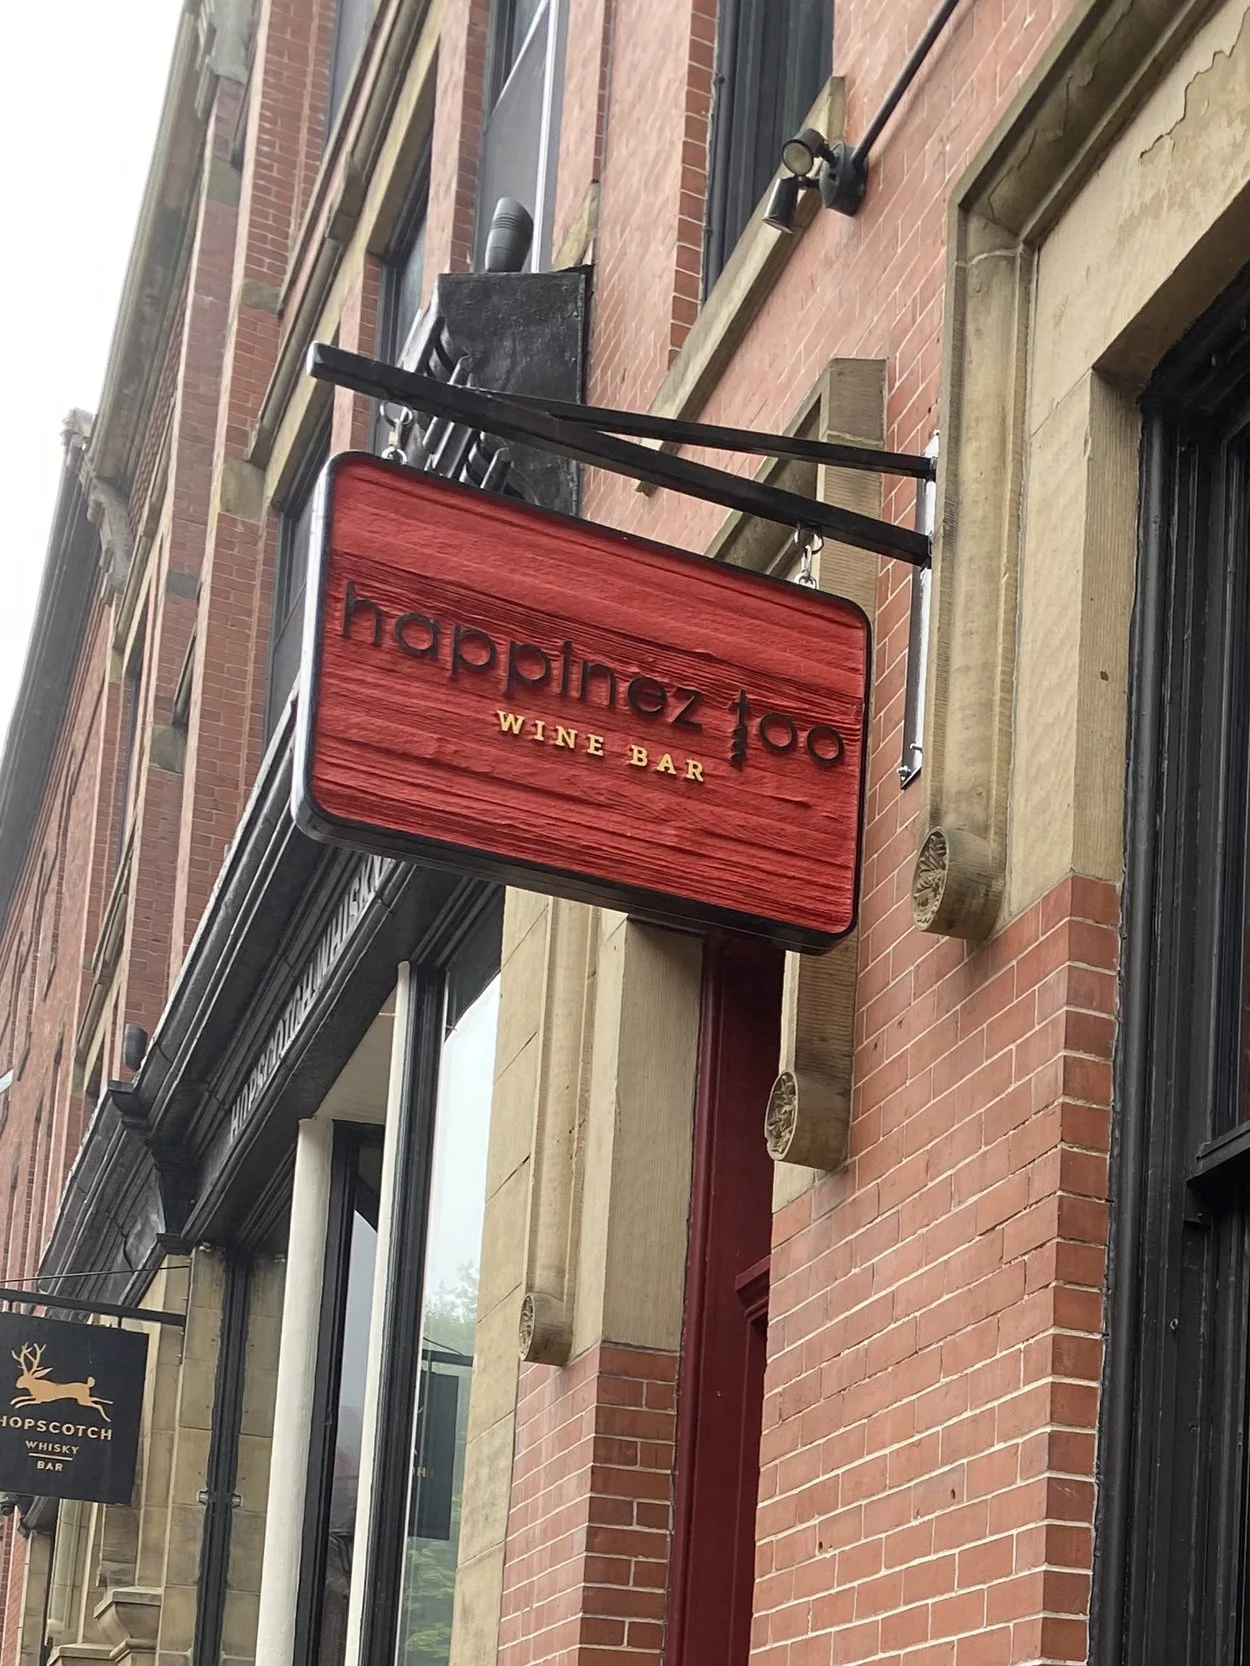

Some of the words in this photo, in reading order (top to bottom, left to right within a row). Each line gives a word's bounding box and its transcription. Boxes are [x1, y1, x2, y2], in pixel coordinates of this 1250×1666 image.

[340, 580, 705, 728] happinez
[730, 688, 846, 770] too
[496, 710, 605, 757] WINE
[630, 743, 705, 782] BAR
[229, 962, 317, 1144] HOPSCOTCH
[0, 1415, 112, 1441] HOPSCOTCH
[25, 1440, 79, 1455] WHISKY
[36, 1460, 63, 1472] BAR
